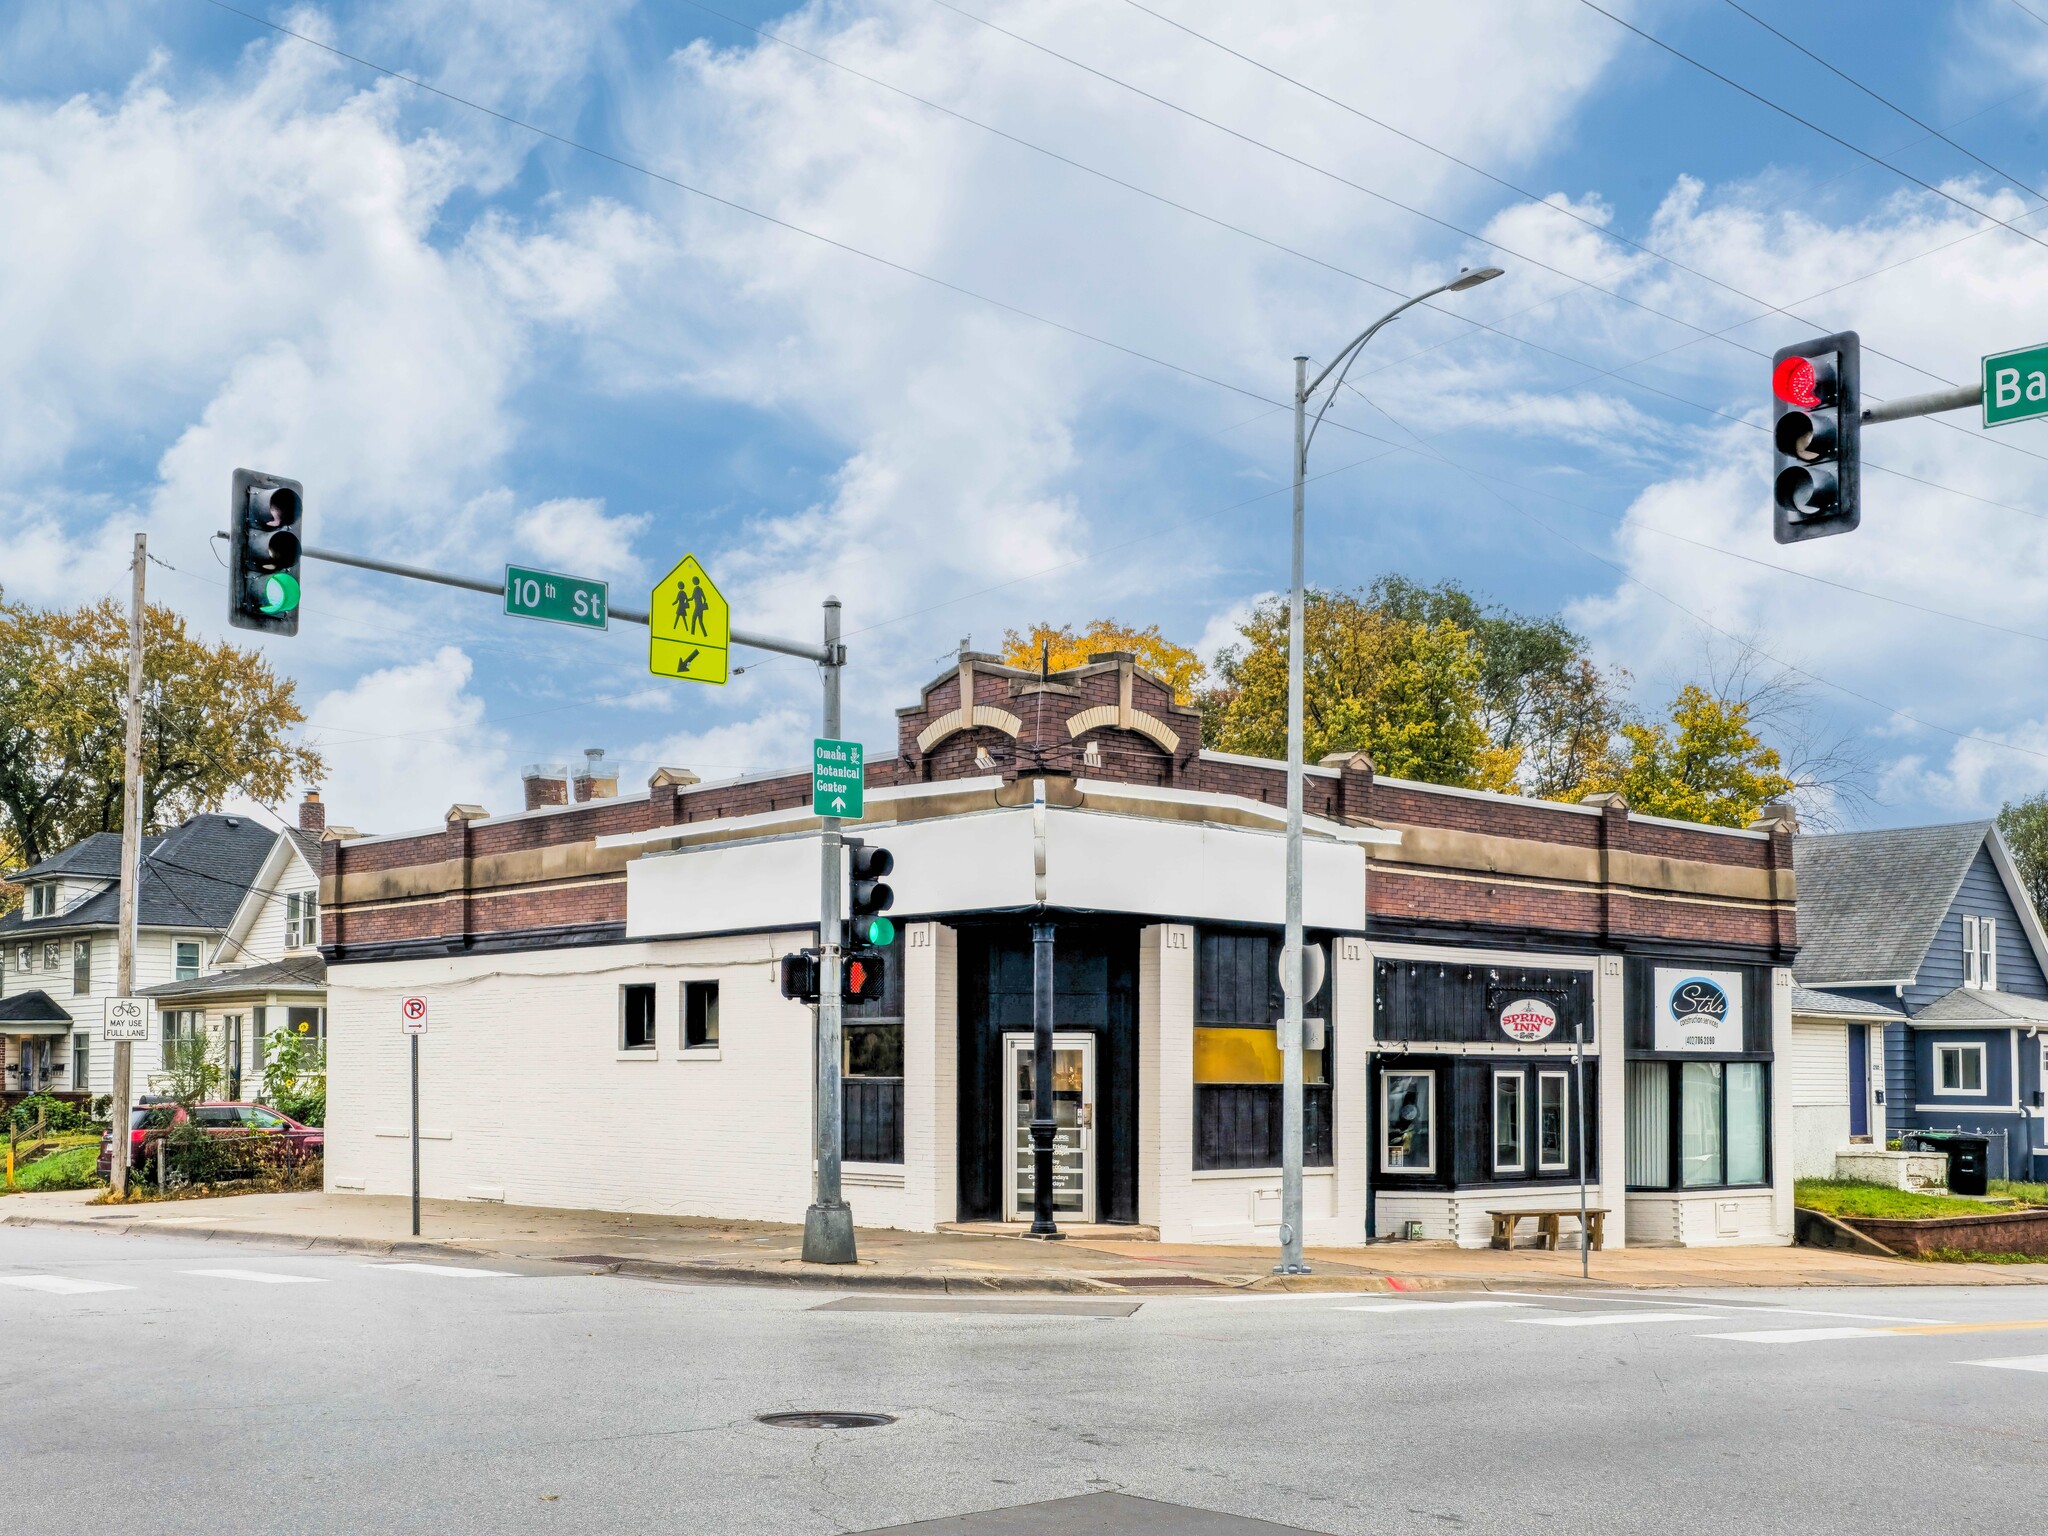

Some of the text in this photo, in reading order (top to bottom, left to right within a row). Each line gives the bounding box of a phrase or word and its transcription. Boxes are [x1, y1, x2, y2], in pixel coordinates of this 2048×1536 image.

[572, 589, 600, 619] St
[816, 745, 847, 761] Omaha
[816, 763, 860, 779] Botanical
[816, 779, 847, 793] Center
[1673, 985, 1728, 1014] Stile
[1502, 1013, 1554, 1027] SPRING
[1513, 1022, 1541, 1032] INN
